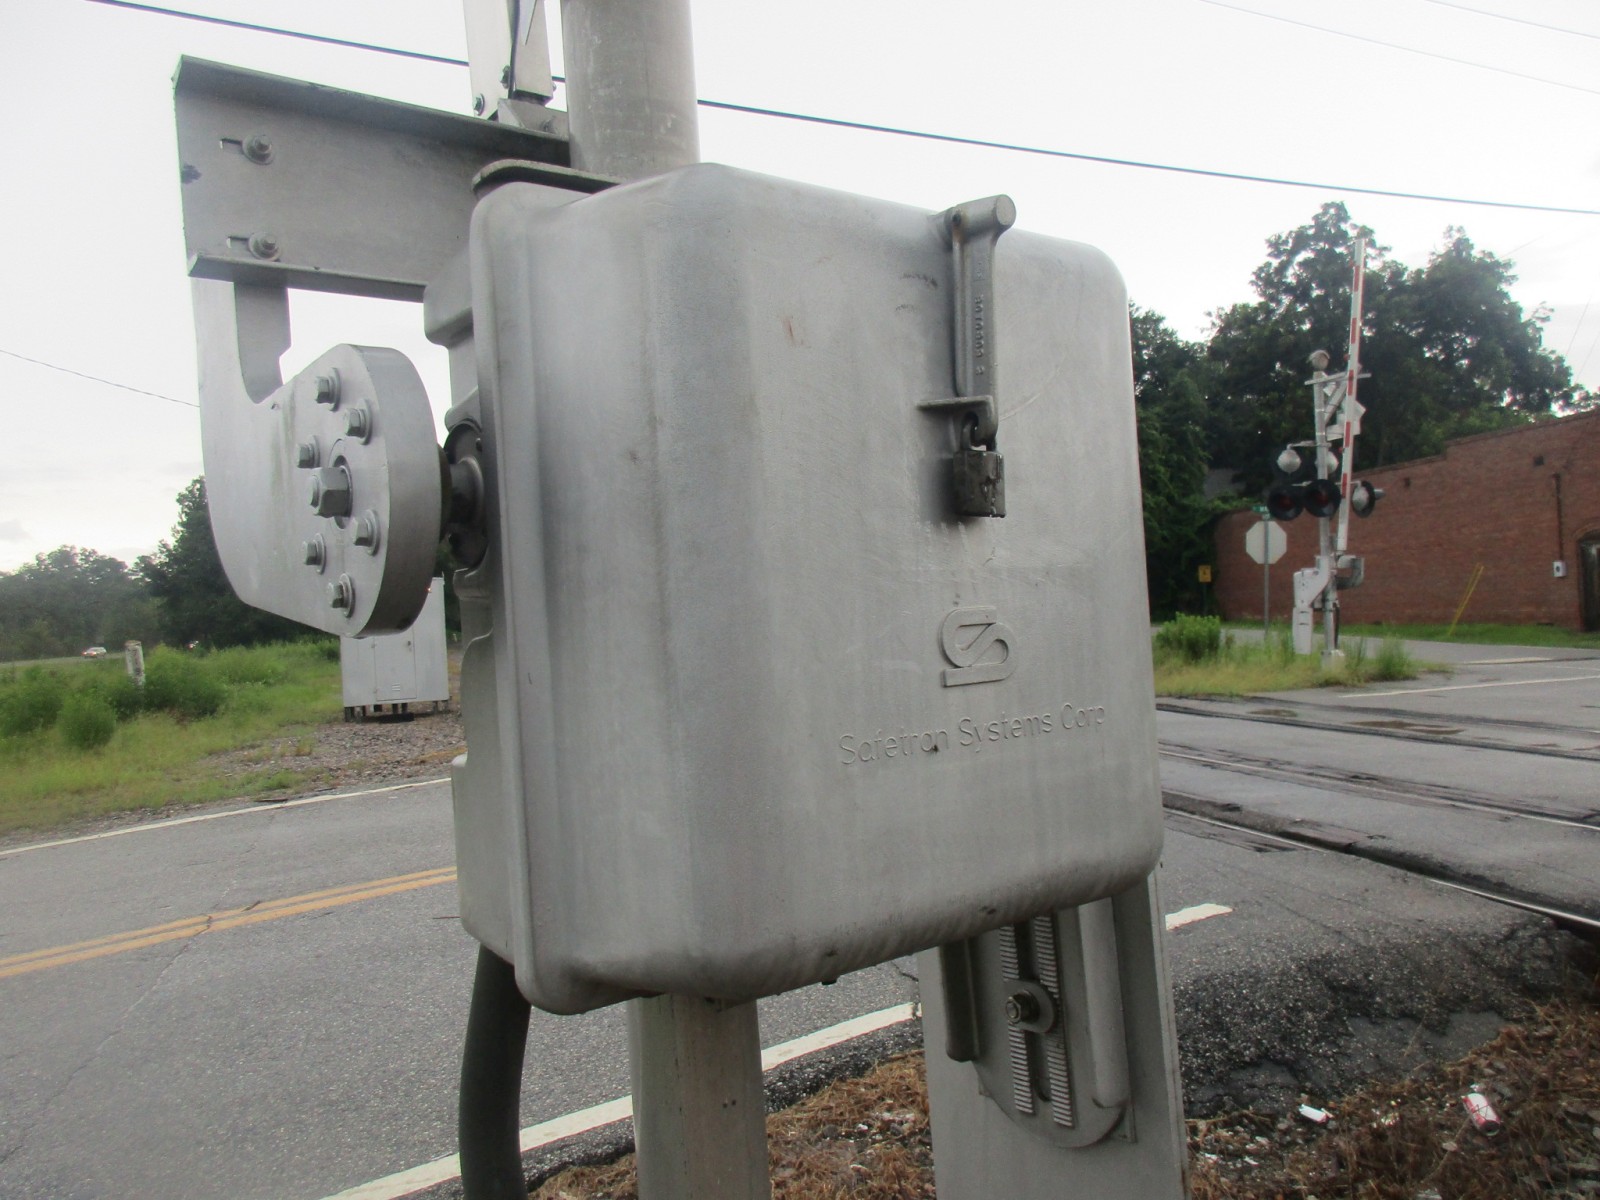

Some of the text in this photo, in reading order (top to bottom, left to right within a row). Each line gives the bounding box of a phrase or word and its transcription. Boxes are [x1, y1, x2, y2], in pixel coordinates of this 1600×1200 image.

[839, 702, 1105, 765] Safetran Systems Corp
